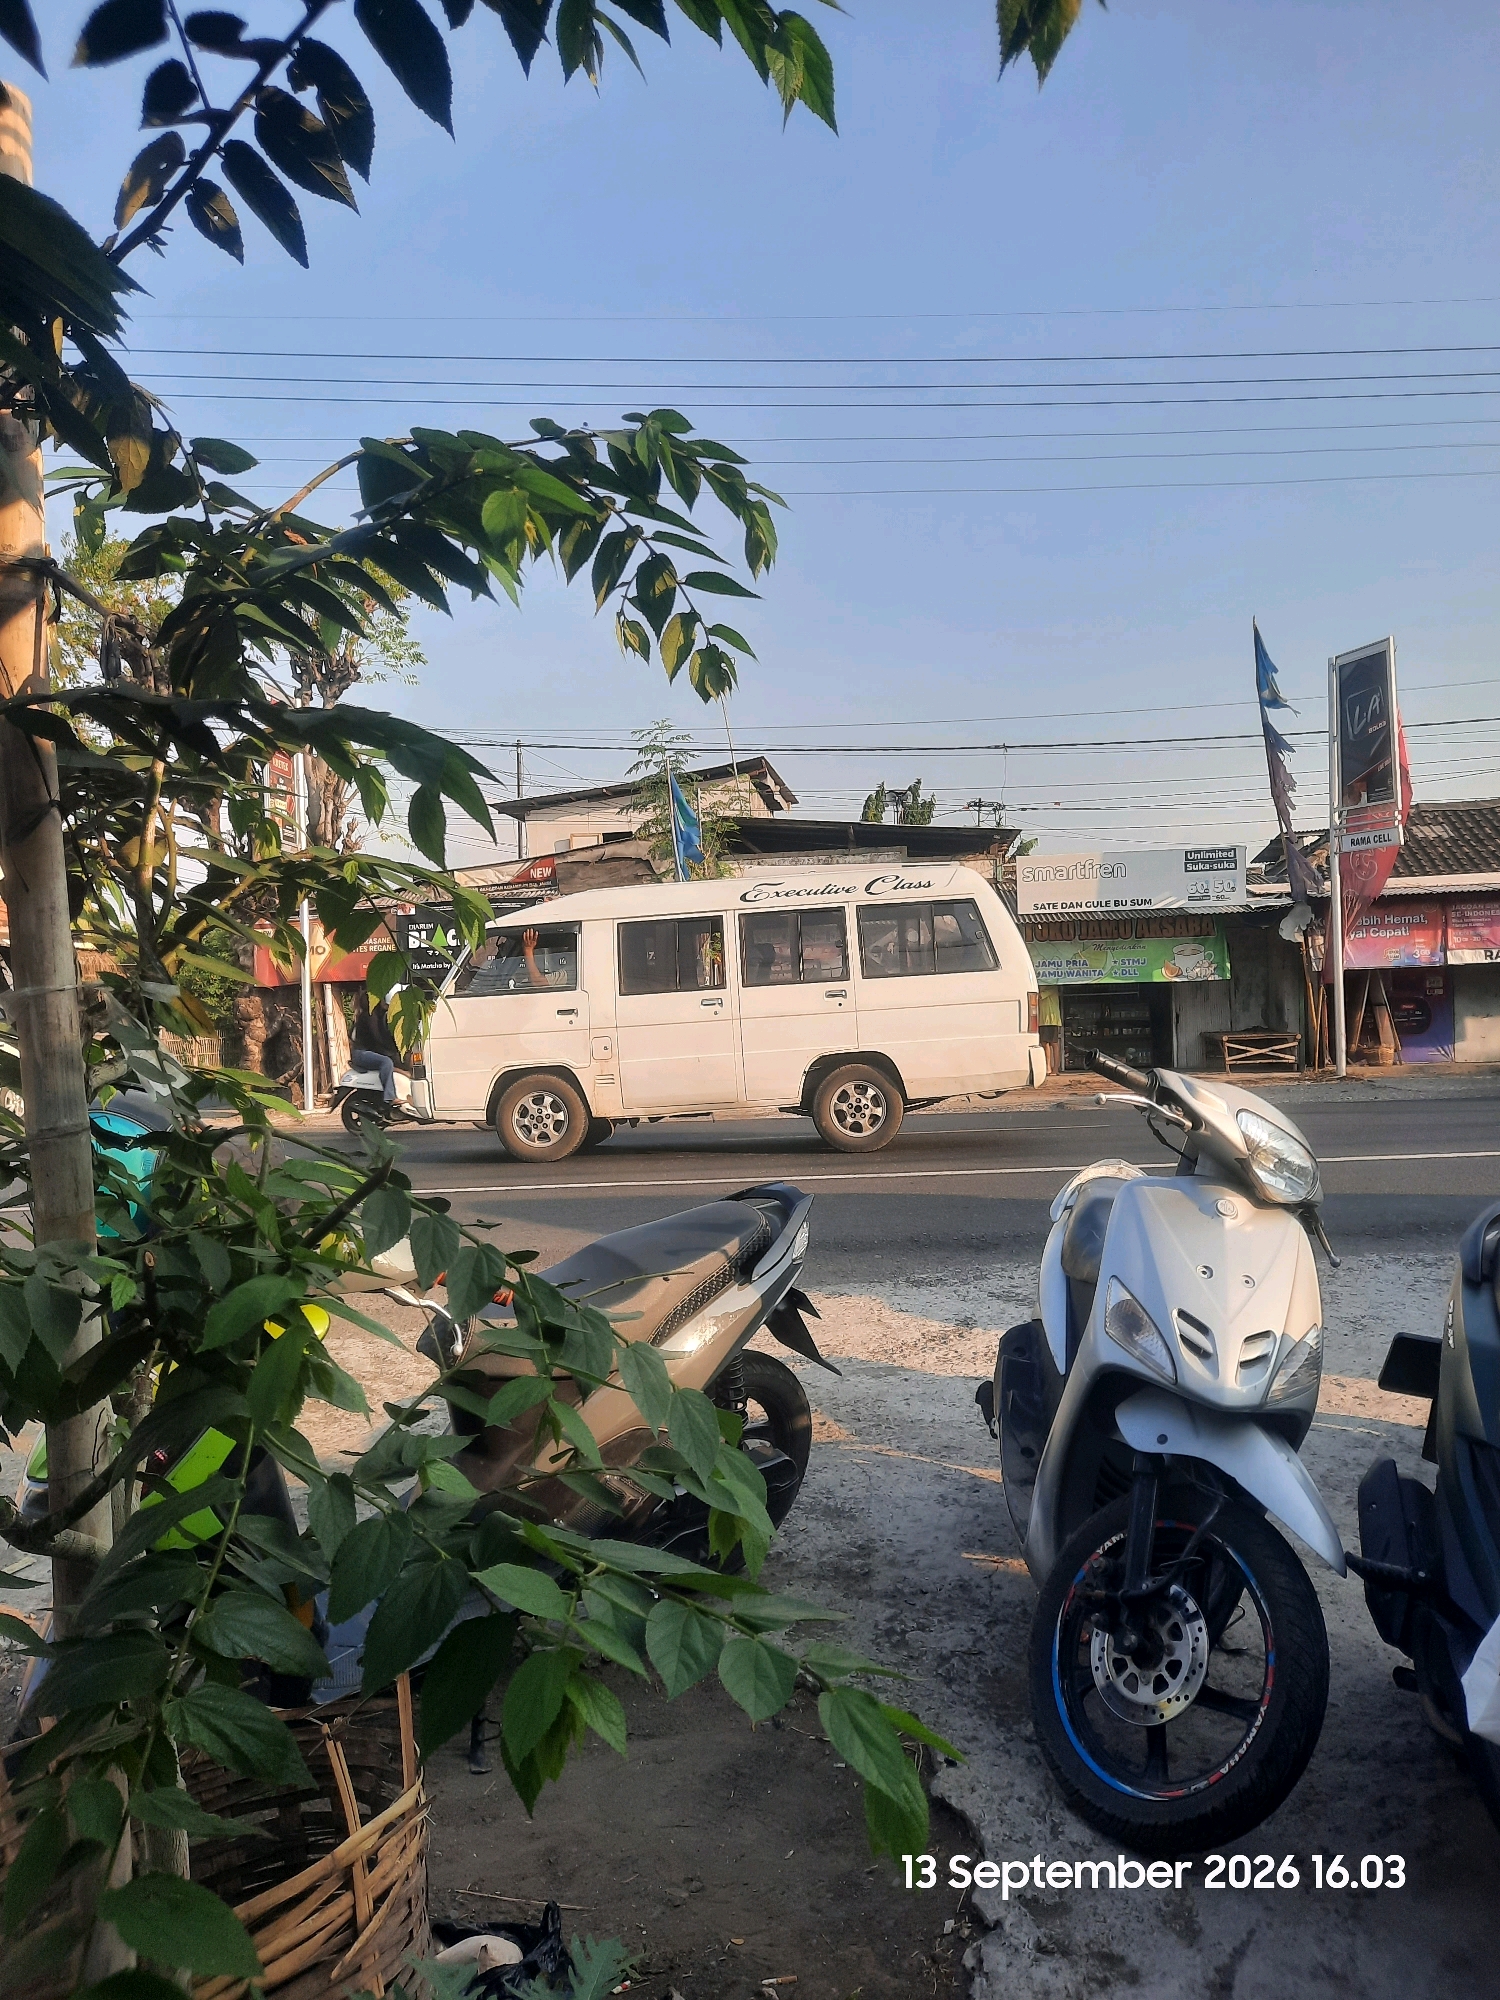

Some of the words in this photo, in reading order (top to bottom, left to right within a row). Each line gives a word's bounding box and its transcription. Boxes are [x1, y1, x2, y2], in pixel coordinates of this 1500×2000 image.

[1350, 835, 1372, 847] RAMA
[1373, 833, 1392, 844] CELL
[1187, 850, 1234, 859] Unlimited
[530, 866, 552, 879] NEW
[1022, 859, 1126, 882] smartfren
[1186, 861, 1235, 871] Suka-suka
[739, 882, 859, 902] Executive
[864, 874, 936, 896] Class
[1033, 902, 1059, 911] SATE
[1060, 901, 1083, 909] DAN
[1084, 900, 1111, 908] GULE
[1113, 899, 1128, 907] BU
[1129, 898, 1152, 907] SUM
[1356, 915, 1381, 926] ebih
[1384, 913, 1428, 926] Hemat,
[1078, 919, 1132, 940] JAMU
[1370, 926, 1410, 939] Cepat!
[421, 962, 442, 970] Matcha
[444, 962, 451, 970] by
[1035, 960, 1063, 968] JAMU
[1120, 958, 1146, 966] STMJ
[1065, 969, 1104, 978] WANITA
[1121, 968, 1139, 976] DLL
[1096, 1533, 1127, 1555] YAM
[1219, 1705, 1268, 1775] YAMAHA
